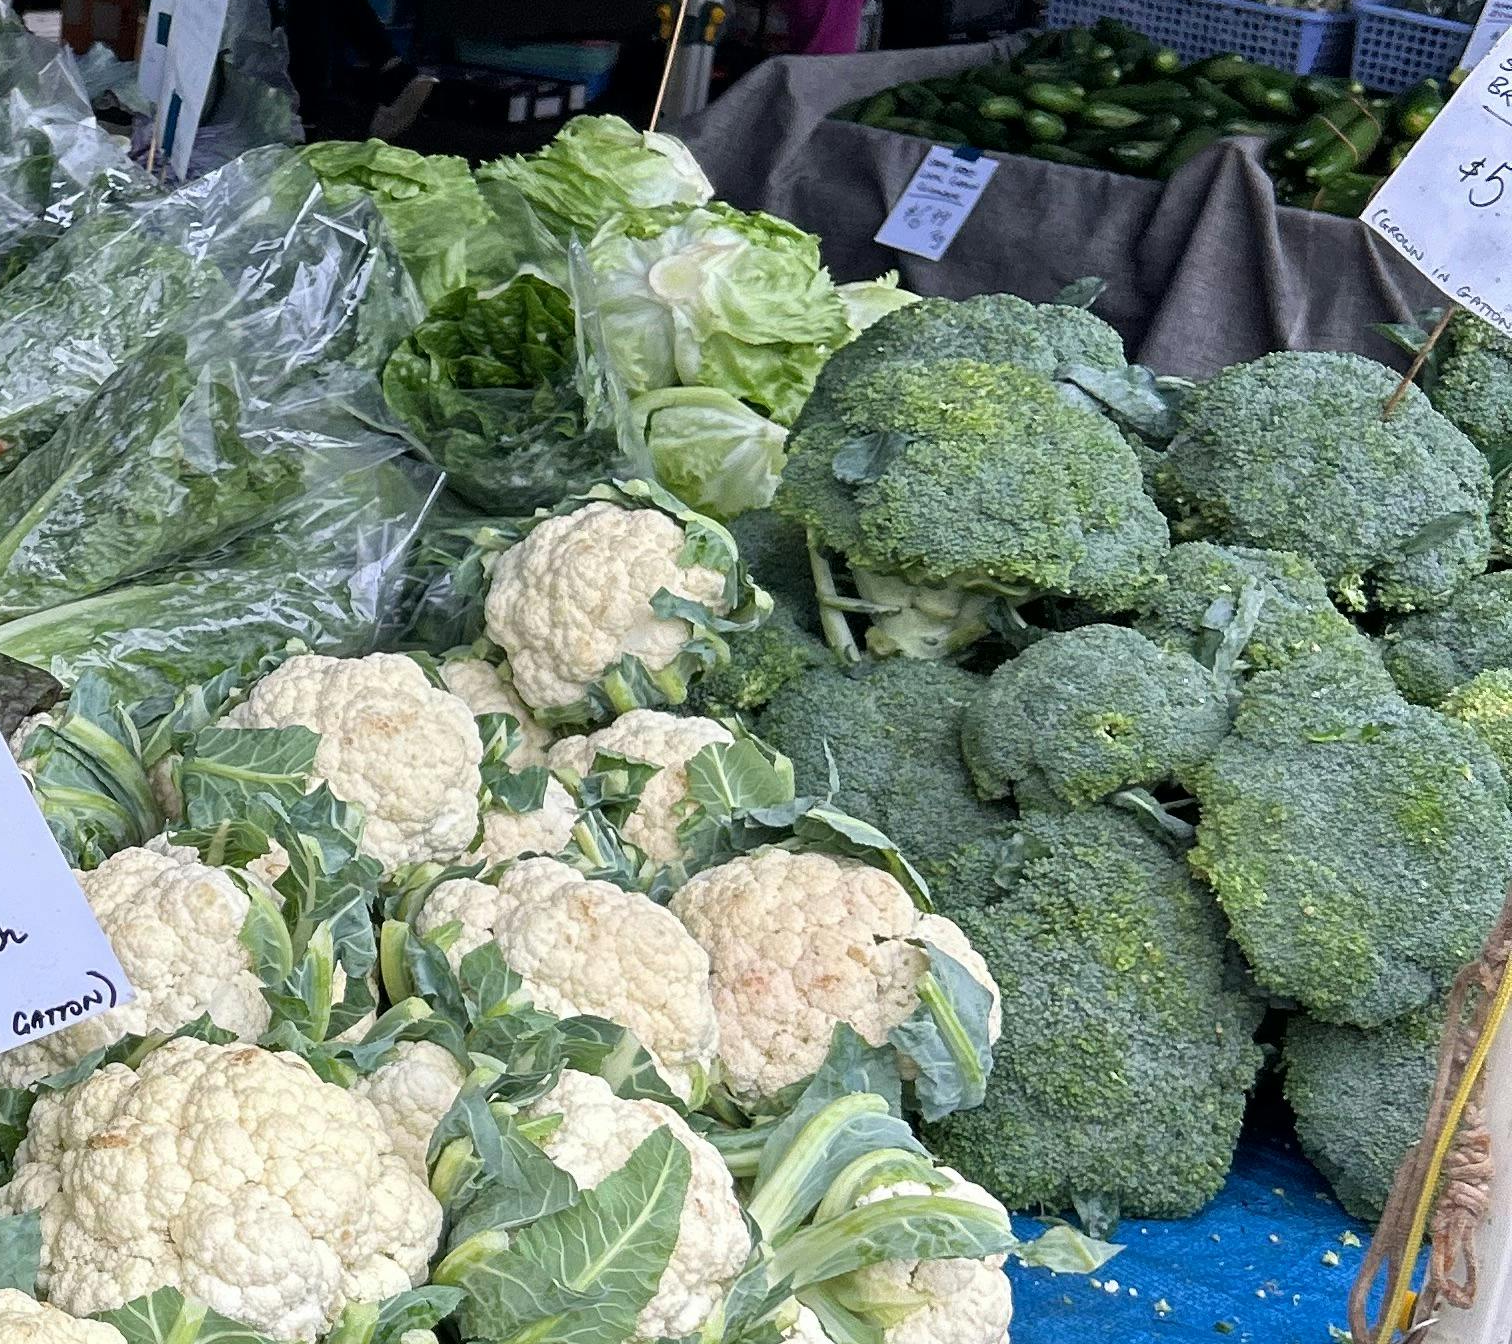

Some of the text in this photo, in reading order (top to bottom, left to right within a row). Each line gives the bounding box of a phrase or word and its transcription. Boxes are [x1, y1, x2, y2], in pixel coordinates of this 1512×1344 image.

[1372, 209, 1424, 262] (GROWN
[1457, 287, 1512, 330] GATTON
[13, 971, 116, 1035] GATTON)
